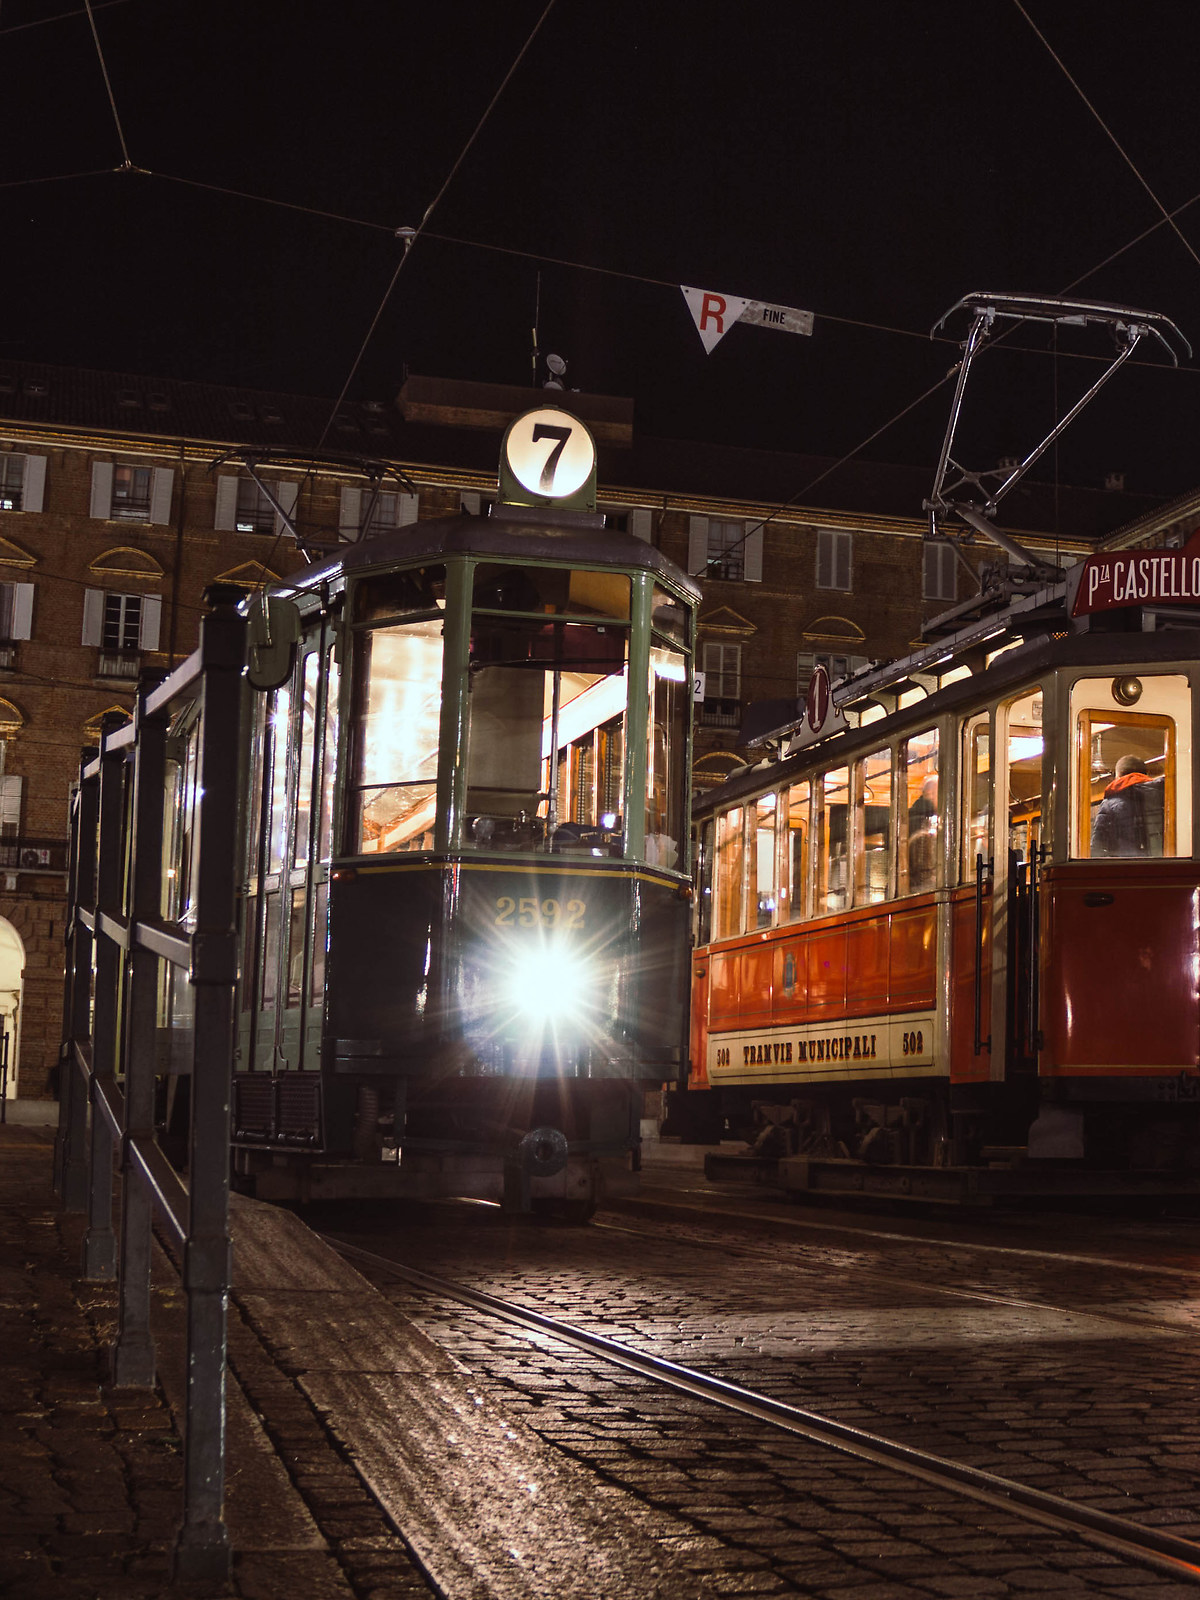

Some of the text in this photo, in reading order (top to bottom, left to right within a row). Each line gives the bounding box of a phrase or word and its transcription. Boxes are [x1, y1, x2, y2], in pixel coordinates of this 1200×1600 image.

[700, 292, 727, 334] R
[763, 308, 786, 325] FINE
[532, 423, 573, 492] 7
[494, 896, 586, 929] 2592
[717, 1030, 923, 1067] 502 TRAMVIE MUNICIPALI 502
